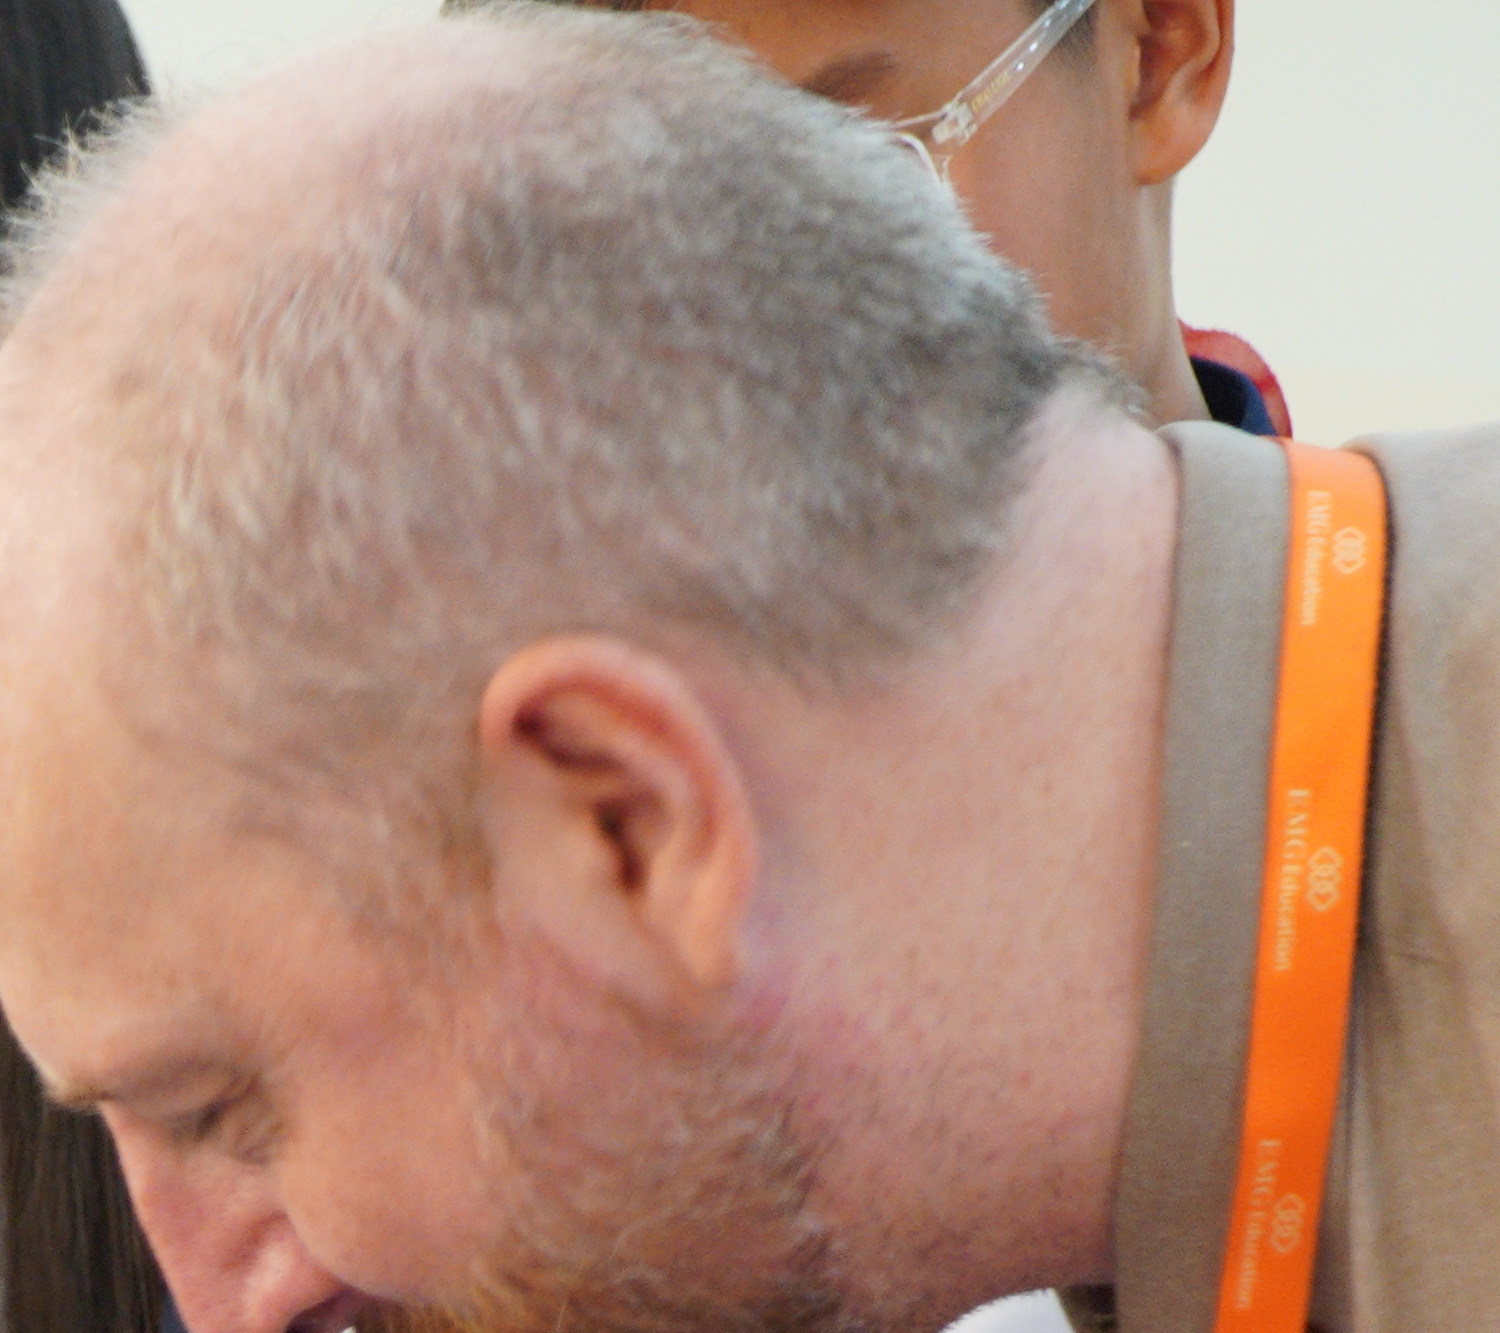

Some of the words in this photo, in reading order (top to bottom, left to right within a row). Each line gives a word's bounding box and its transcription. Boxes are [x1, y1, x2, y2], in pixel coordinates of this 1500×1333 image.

[1306, 489, 1331, 534] EMG
[1300, 536, 1327, 626] Education
[1284, 788, 1311, 859] EMG
[1274, 863, 1302, 972] Education
[1251, 1138, 1282, 1206] EMG
[1235, 1209, 1267, 1309] Education
